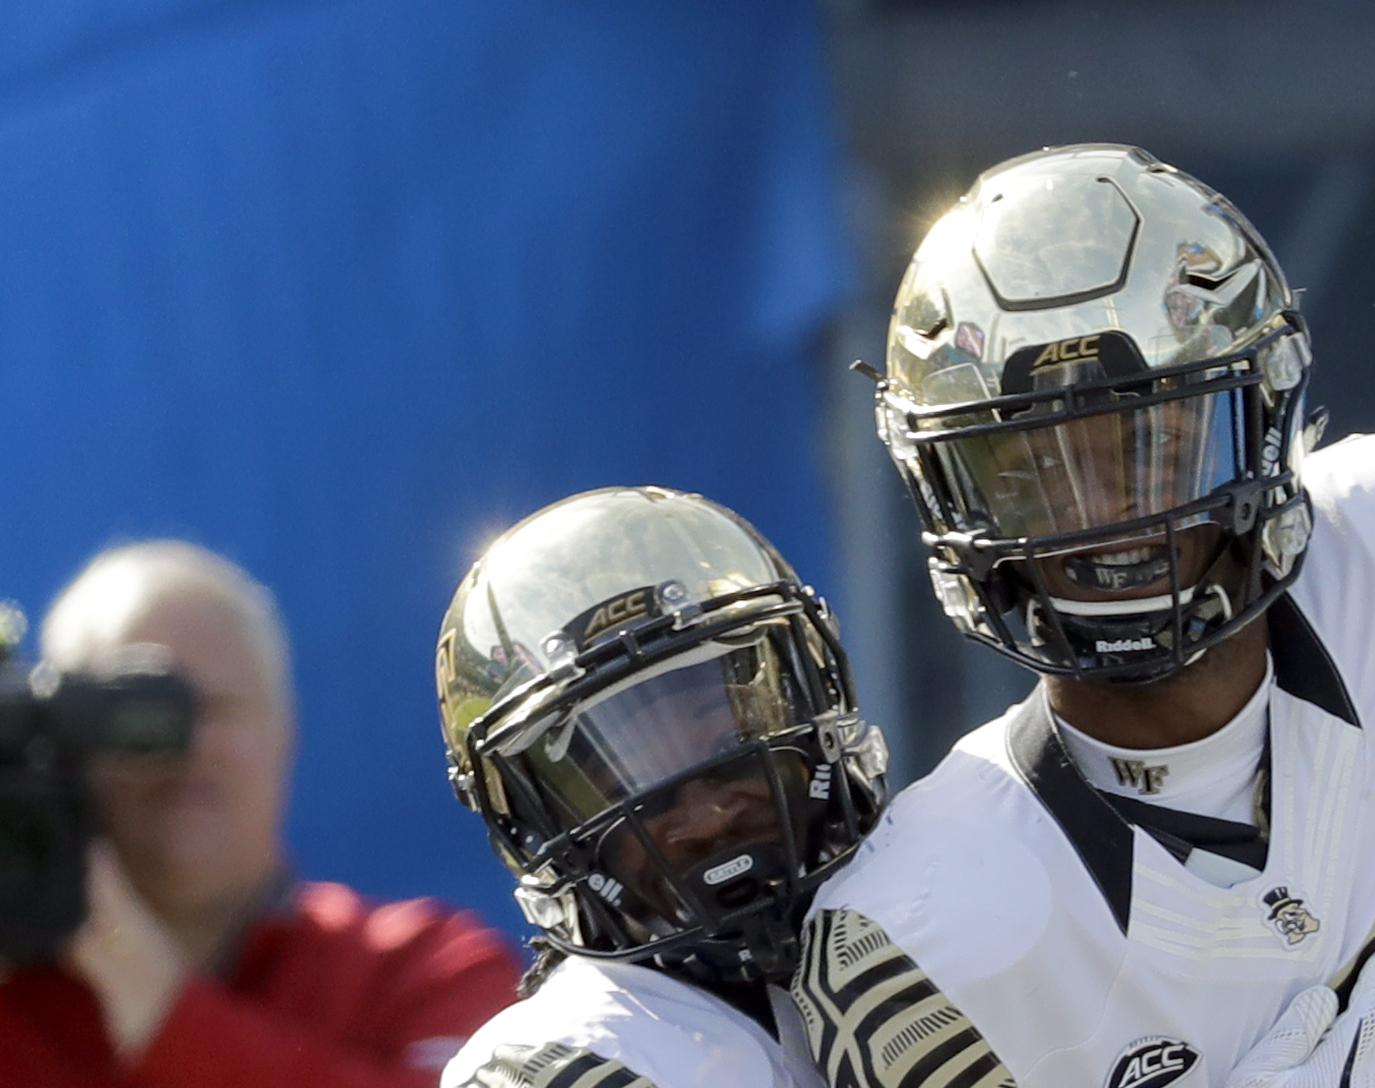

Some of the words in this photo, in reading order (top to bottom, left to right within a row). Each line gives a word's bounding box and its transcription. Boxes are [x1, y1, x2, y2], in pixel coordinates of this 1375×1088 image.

[1033, 335, 1101, 367] ACC
[584, 591, 647, 637] ACC
[1107, 755, 1169, 795] WF
[1117, 1044, 1185, 1088] ACC
